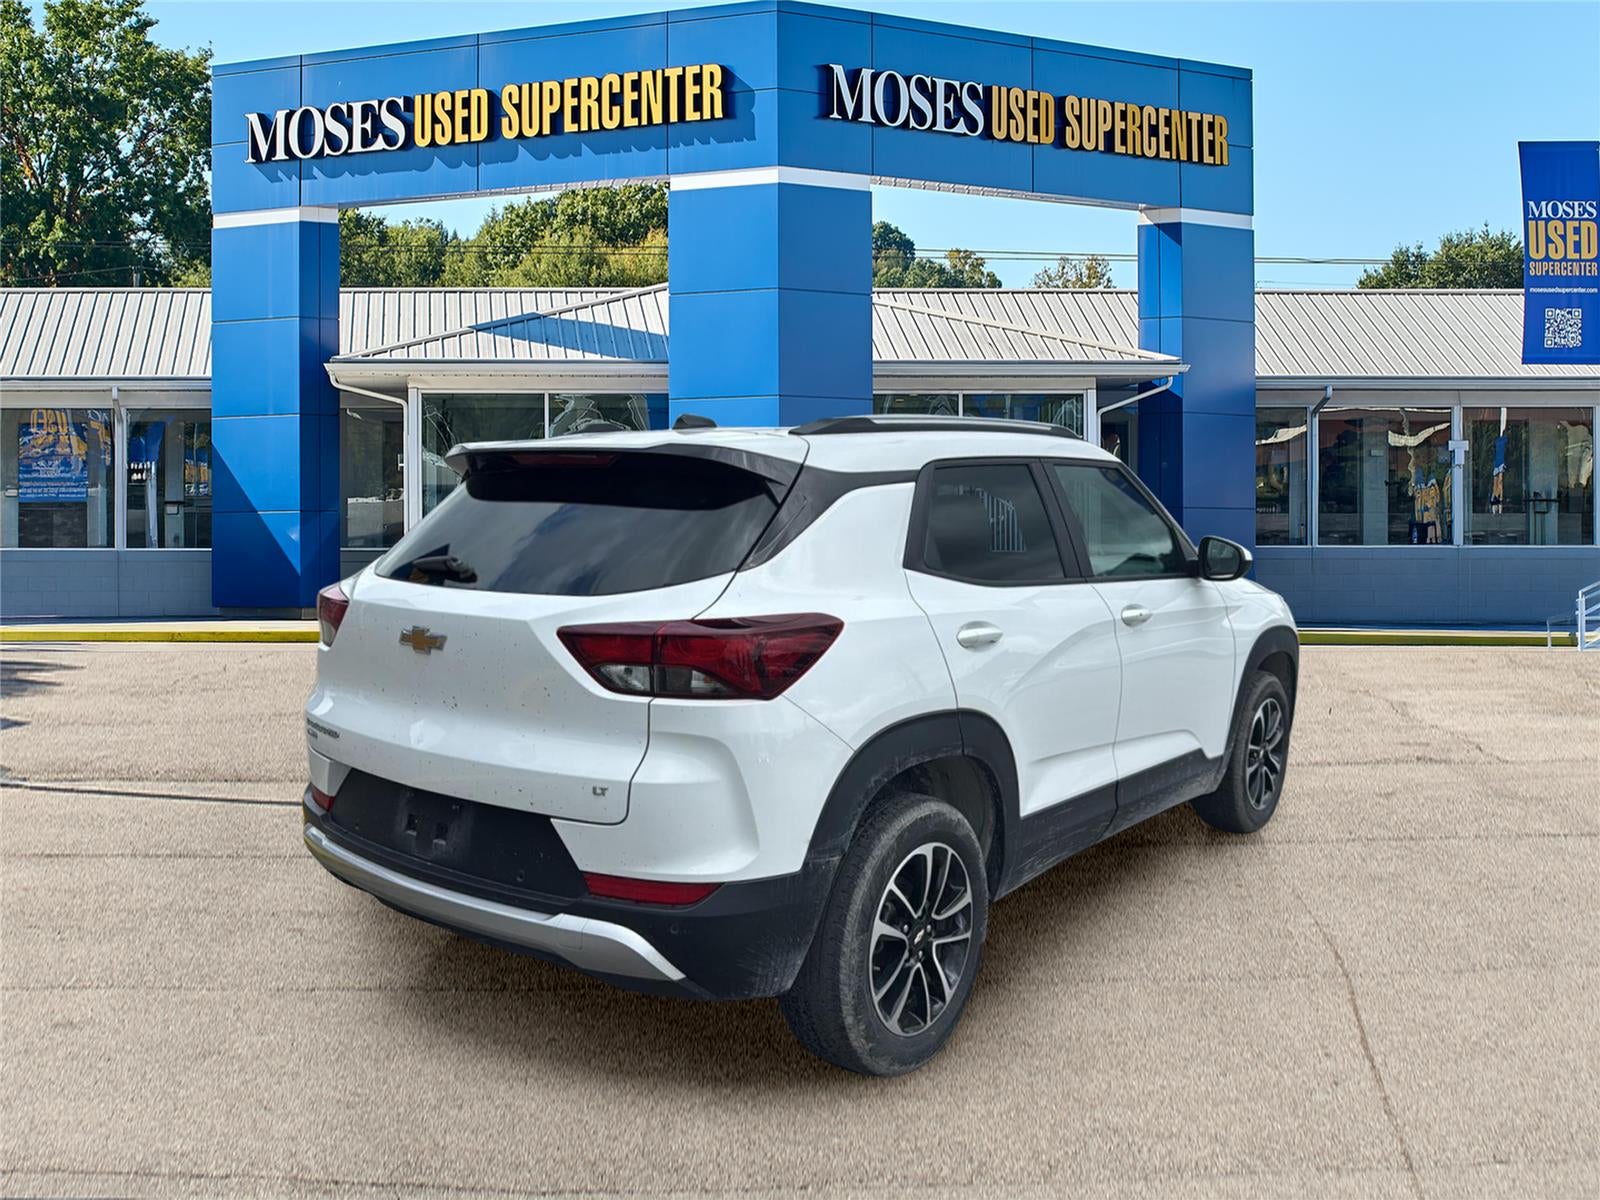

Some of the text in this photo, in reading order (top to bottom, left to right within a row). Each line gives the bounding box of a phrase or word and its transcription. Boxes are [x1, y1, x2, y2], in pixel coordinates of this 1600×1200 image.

[244, 63, 724, 164] MOSES USED SUPERCENTER
[828, 64, 1230, 166] MOSES USED SUPERCENTER
[1528, 200, 1598, 219] MOSES
[1528, 220, 1598, 260] USED
[1529, 261, 1598, 277] SUPERCENTER
[592, 786, 608, 797] LT
